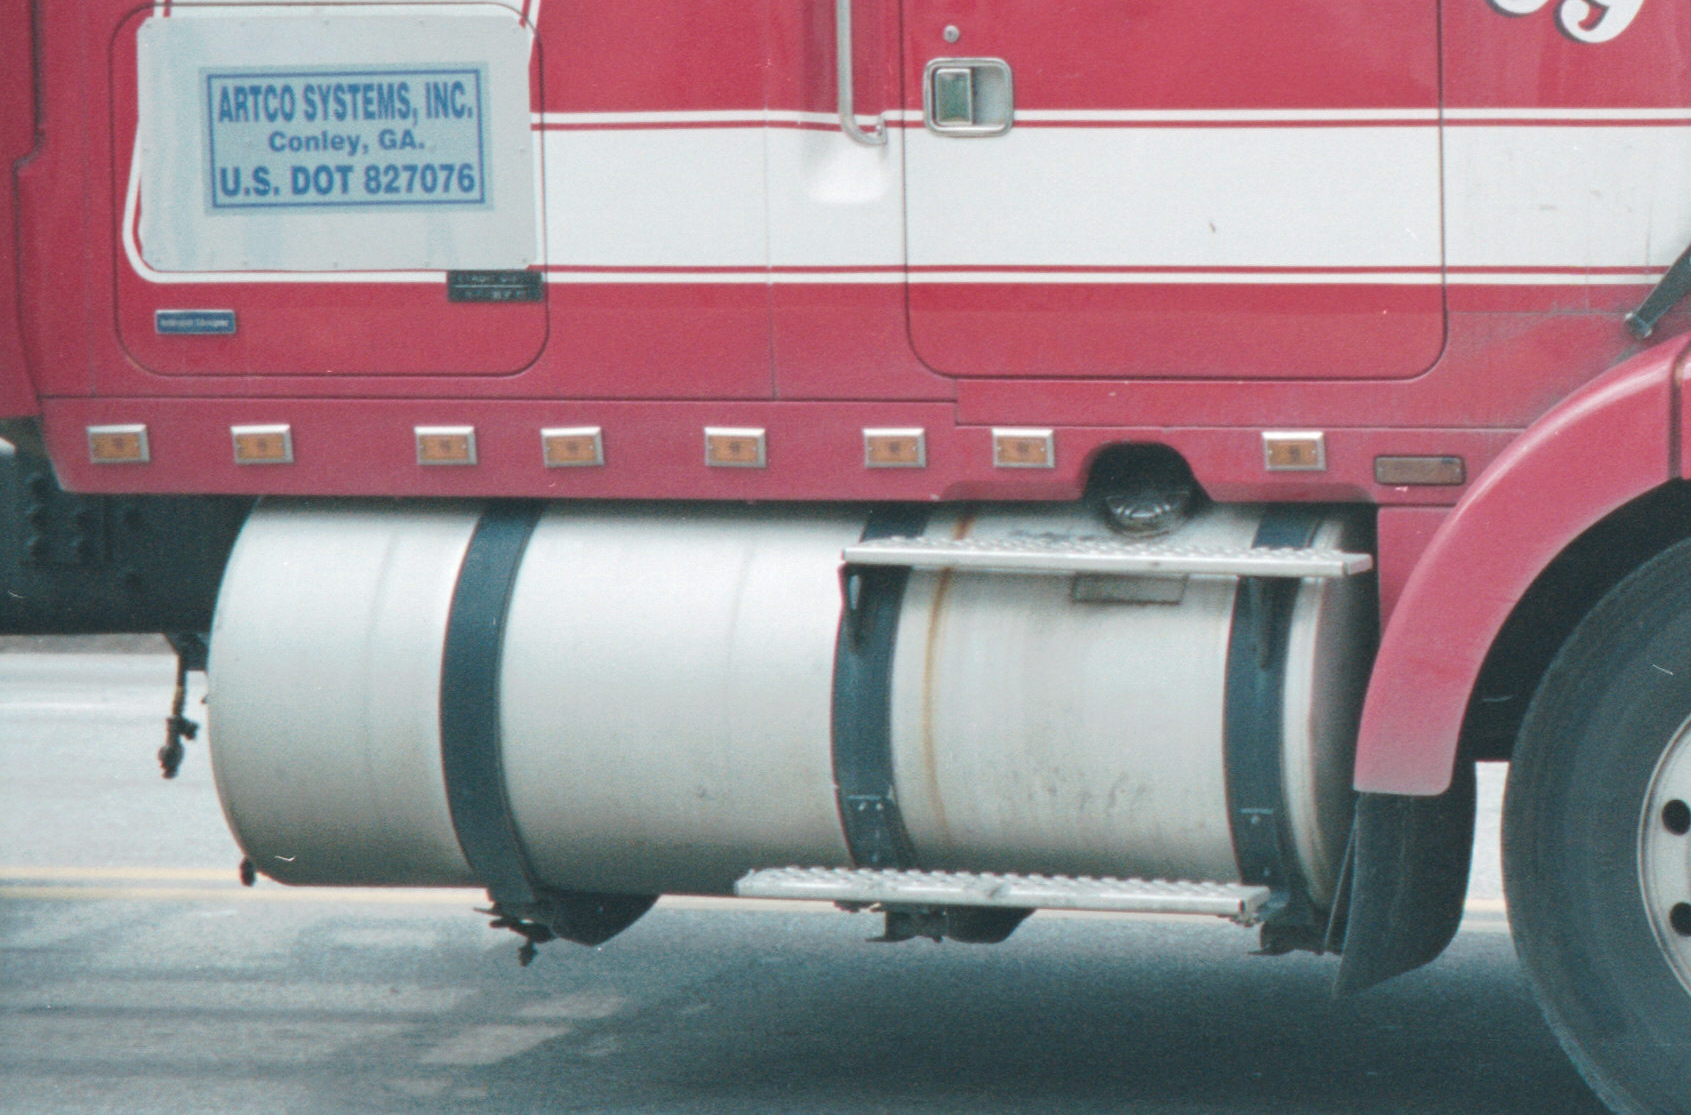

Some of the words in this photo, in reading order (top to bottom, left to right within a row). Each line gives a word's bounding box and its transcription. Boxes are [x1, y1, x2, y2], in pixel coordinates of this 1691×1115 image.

[219, 84, 296, 123] ARTCO
[303, 82, 418, 127] SYSTEMS,
[425, 81, 473, 119] INC.
[269, 131, 369, 156] Conley,
[378, 129, 425, 150] GA.
[220, 166, 280, 197] U.S.
[292, 165, 354, 195] DOT
[364, 163, 475, 194] 827076
